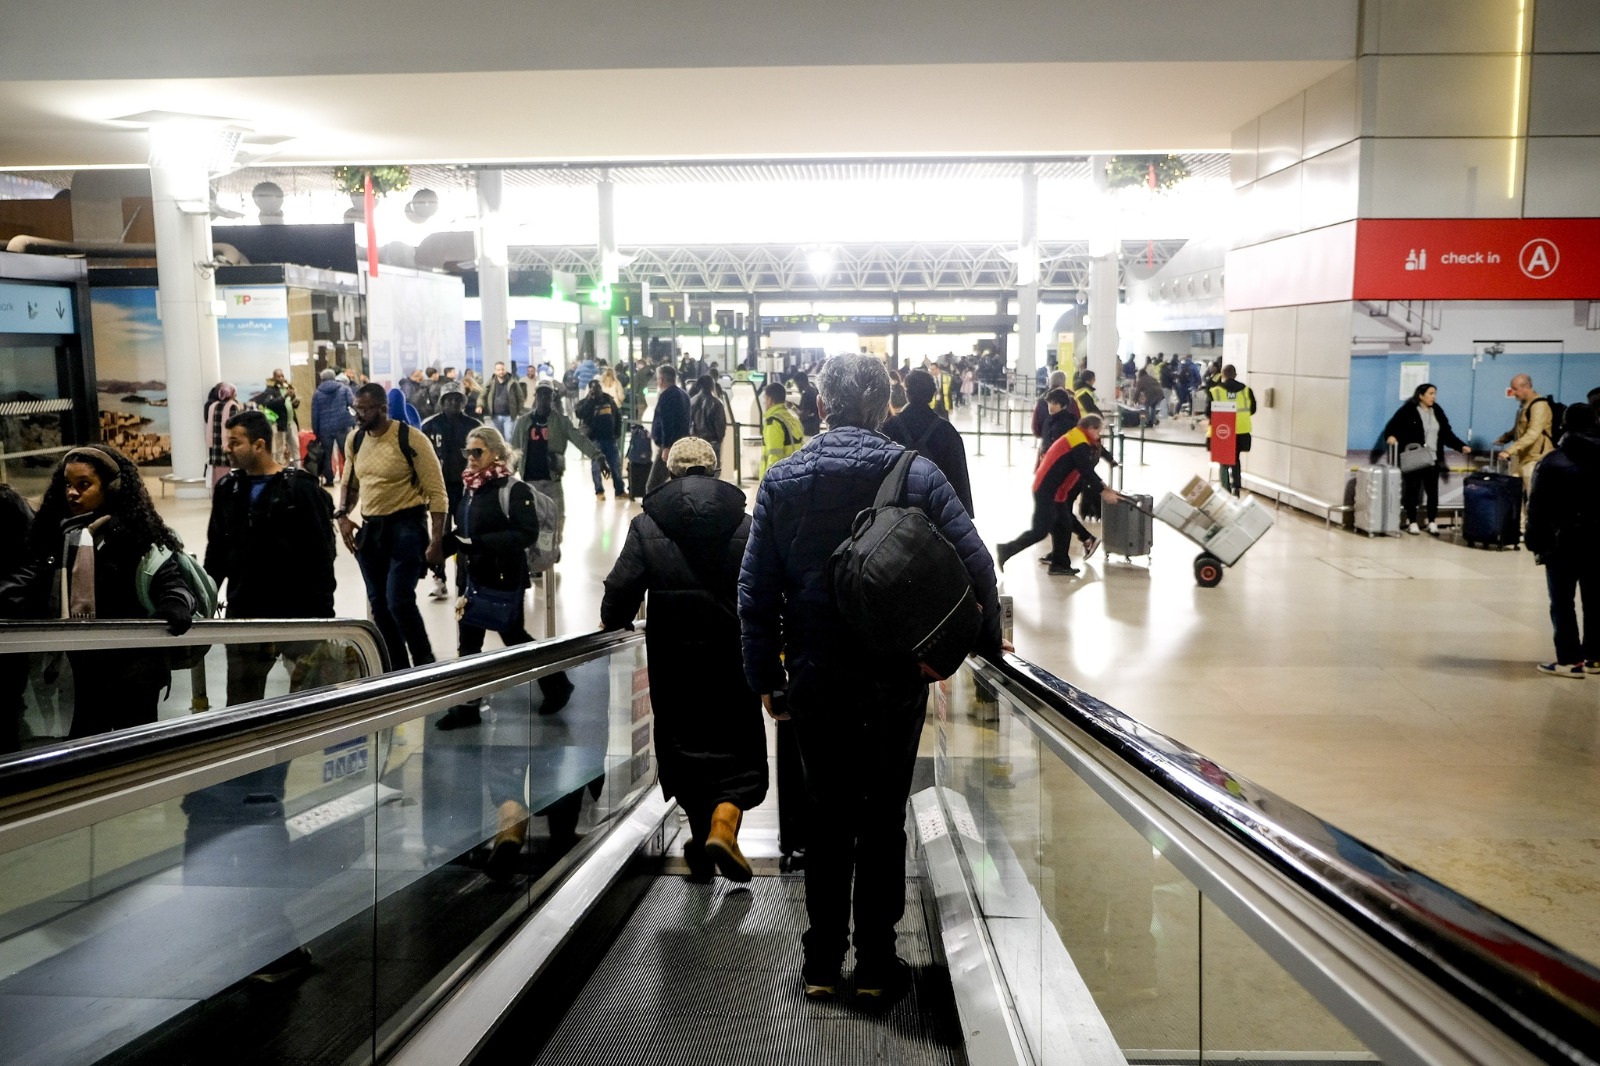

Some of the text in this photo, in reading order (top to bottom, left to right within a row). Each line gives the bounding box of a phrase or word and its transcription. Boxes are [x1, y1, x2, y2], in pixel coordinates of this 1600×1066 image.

[1440, 251, 1501, 265] check in
[1527, 245, 1551, 273] A
[234, 293, 251, 305] TAP
[623, 296, 630, 311] 1
[668, 304, 675, 318] 1
